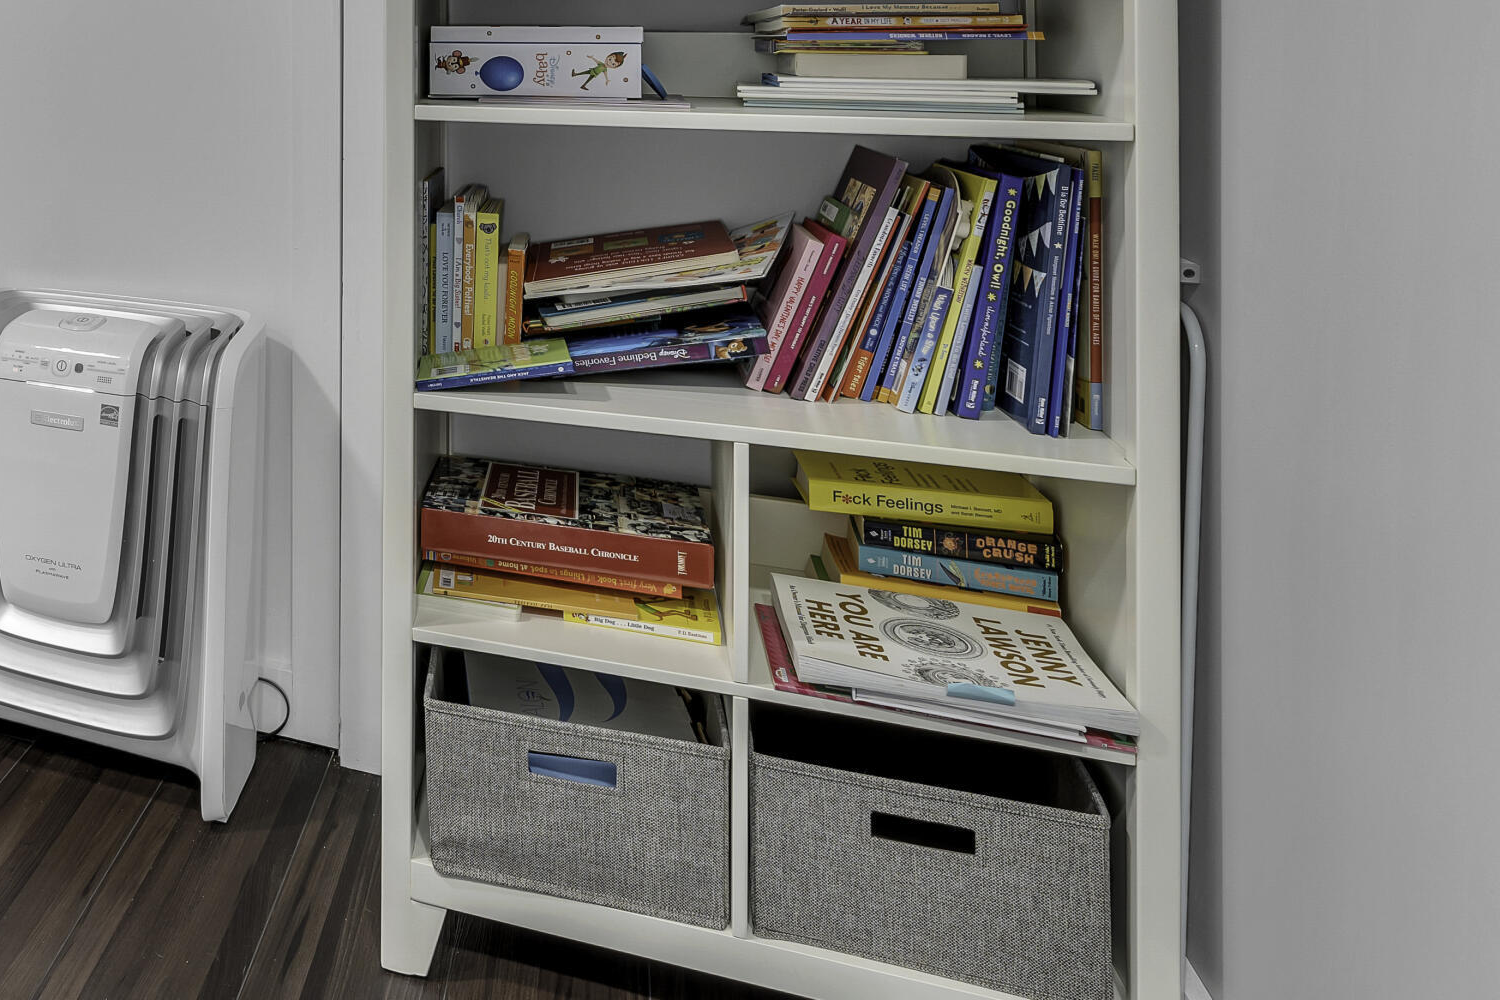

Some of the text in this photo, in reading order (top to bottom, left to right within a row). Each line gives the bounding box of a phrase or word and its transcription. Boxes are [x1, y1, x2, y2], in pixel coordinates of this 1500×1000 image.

[831, 17, 838, 25] A
[840, 17, 862, 25] YEAR
[533, 52, 548, 87] baby
[1060, 199, 1068, 209] for
[1057, 209, 1067, 236] Bedtime
[990, 201, 1016, 289] Goodnight, Owl!
[464, 244, 474, 316] Everybody Potties!
[793, 276, 805, 296] HAPPY
[441, 289, 449, 323] FOREVER
[508, 271, 518, 339] GOODNIGHT MOON
[932, 293, 947, 311] Wish
[1092, 294, 1100, 313] BABIES
[928, 312, 940, 331] Upon
[1092, 321, 1100, 331] ALL
[1092, 332, 1100, 345] AGES
[575, 356, 616, 367] Favorites
[618, 352, 657, 362] Bedtime
[799, 339, 826, 393] CREATIVE CHILD PRESS
[857, 356, 869, 374] tiger
[505, 470, 539, 510] BASEBALL
[877, 495, 944, 515] Feelings
[902, 525, 922, 538] TIM
[487, 534, 639, 562] 20TH CENTURY BASEBALL CHRONICLE
[894, 536, 1038, 554] DORSEY ORANGE
[25, 554, 81, 570] OXYGEN ULTRA
[498, 560, 519, 570] home
[902, 554, 922, 566] TIM
[982, 548, 1034, 565] CRUSH
[520, 563, 528, 571] at
[530, 564, 548, 574] spot
[560, 570, 585, 581] things
[893, 565, 932, 580] DORSEY
[598, 576, 617, 586] book
[639, 582, 657, 592] Very
[594, 616, 655, 632] Big Dog Little Dog
[805, 599, 845, 640] HERE
[835, 593, 890, 662] YOU ARE
[972, 617, 1046, 689] LAWSON
[1015, 629, 1083, 687] JENNY
